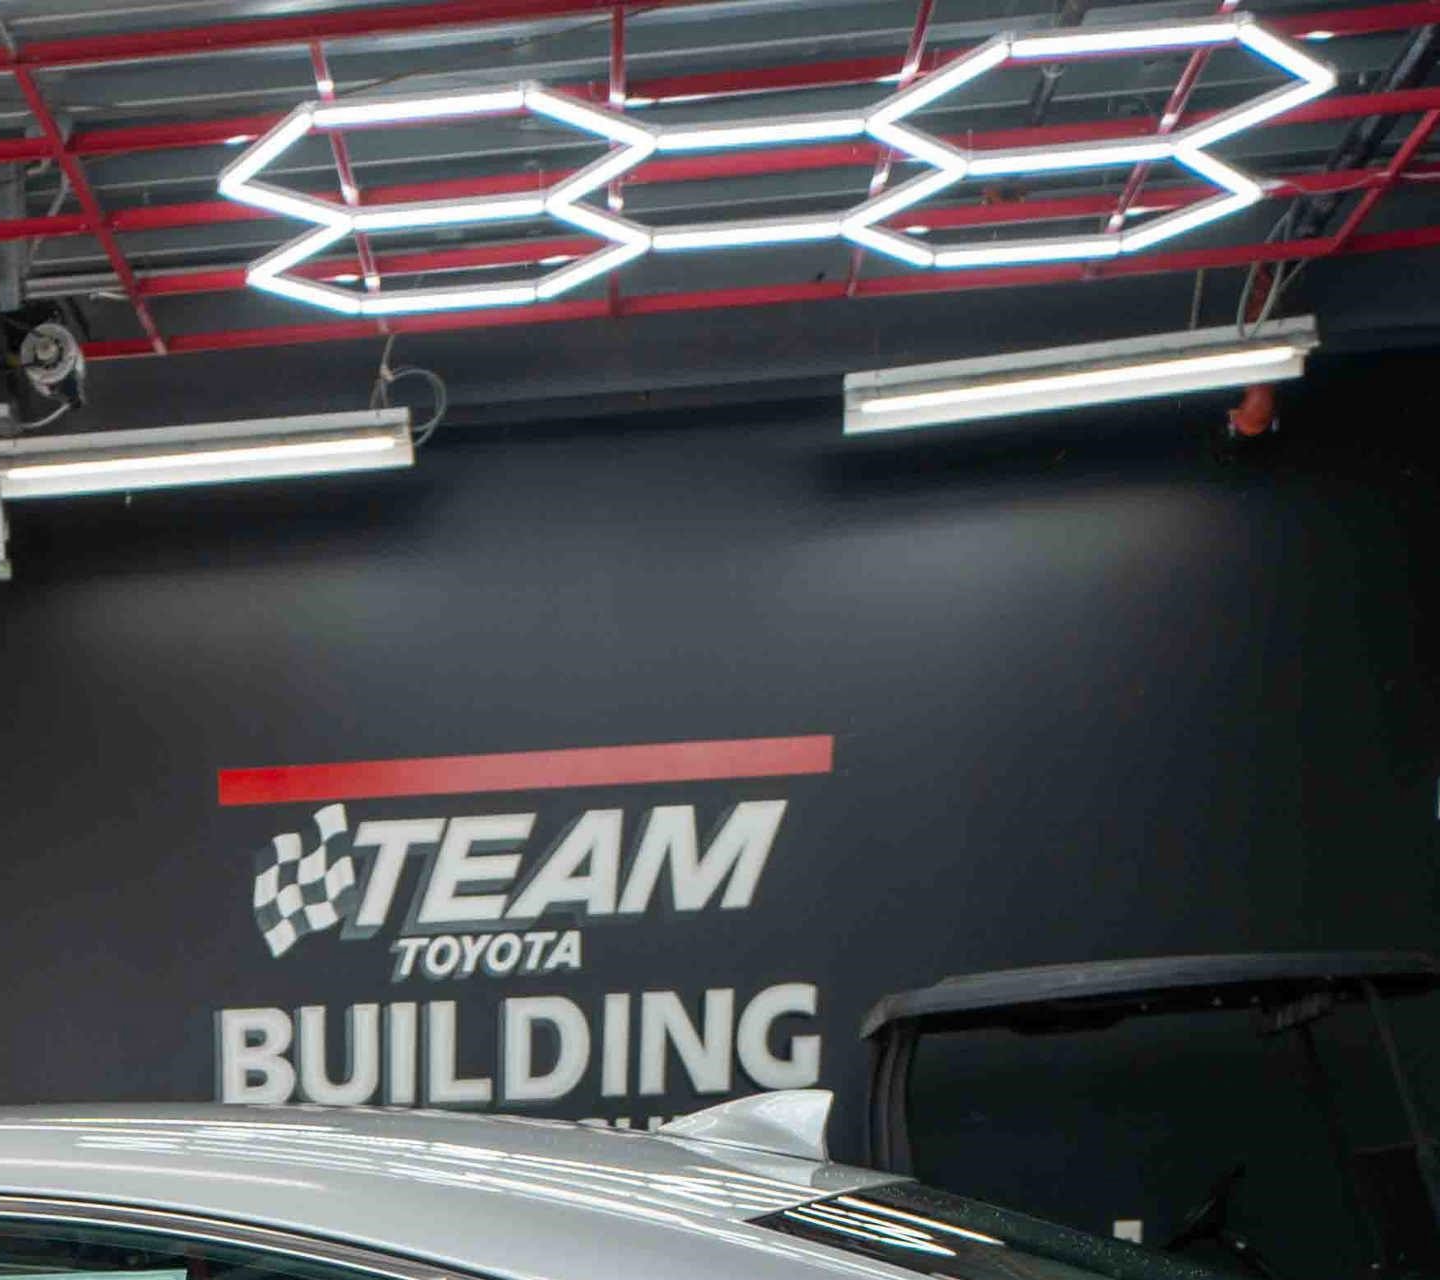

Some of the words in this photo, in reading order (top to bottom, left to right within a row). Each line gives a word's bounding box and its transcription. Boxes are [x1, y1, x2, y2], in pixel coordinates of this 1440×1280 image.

[350, 798, 790, 928] TEAM
[396, 929, 584, 978] TOYOTA
[218, 982, 823, 1106] BUILDING
